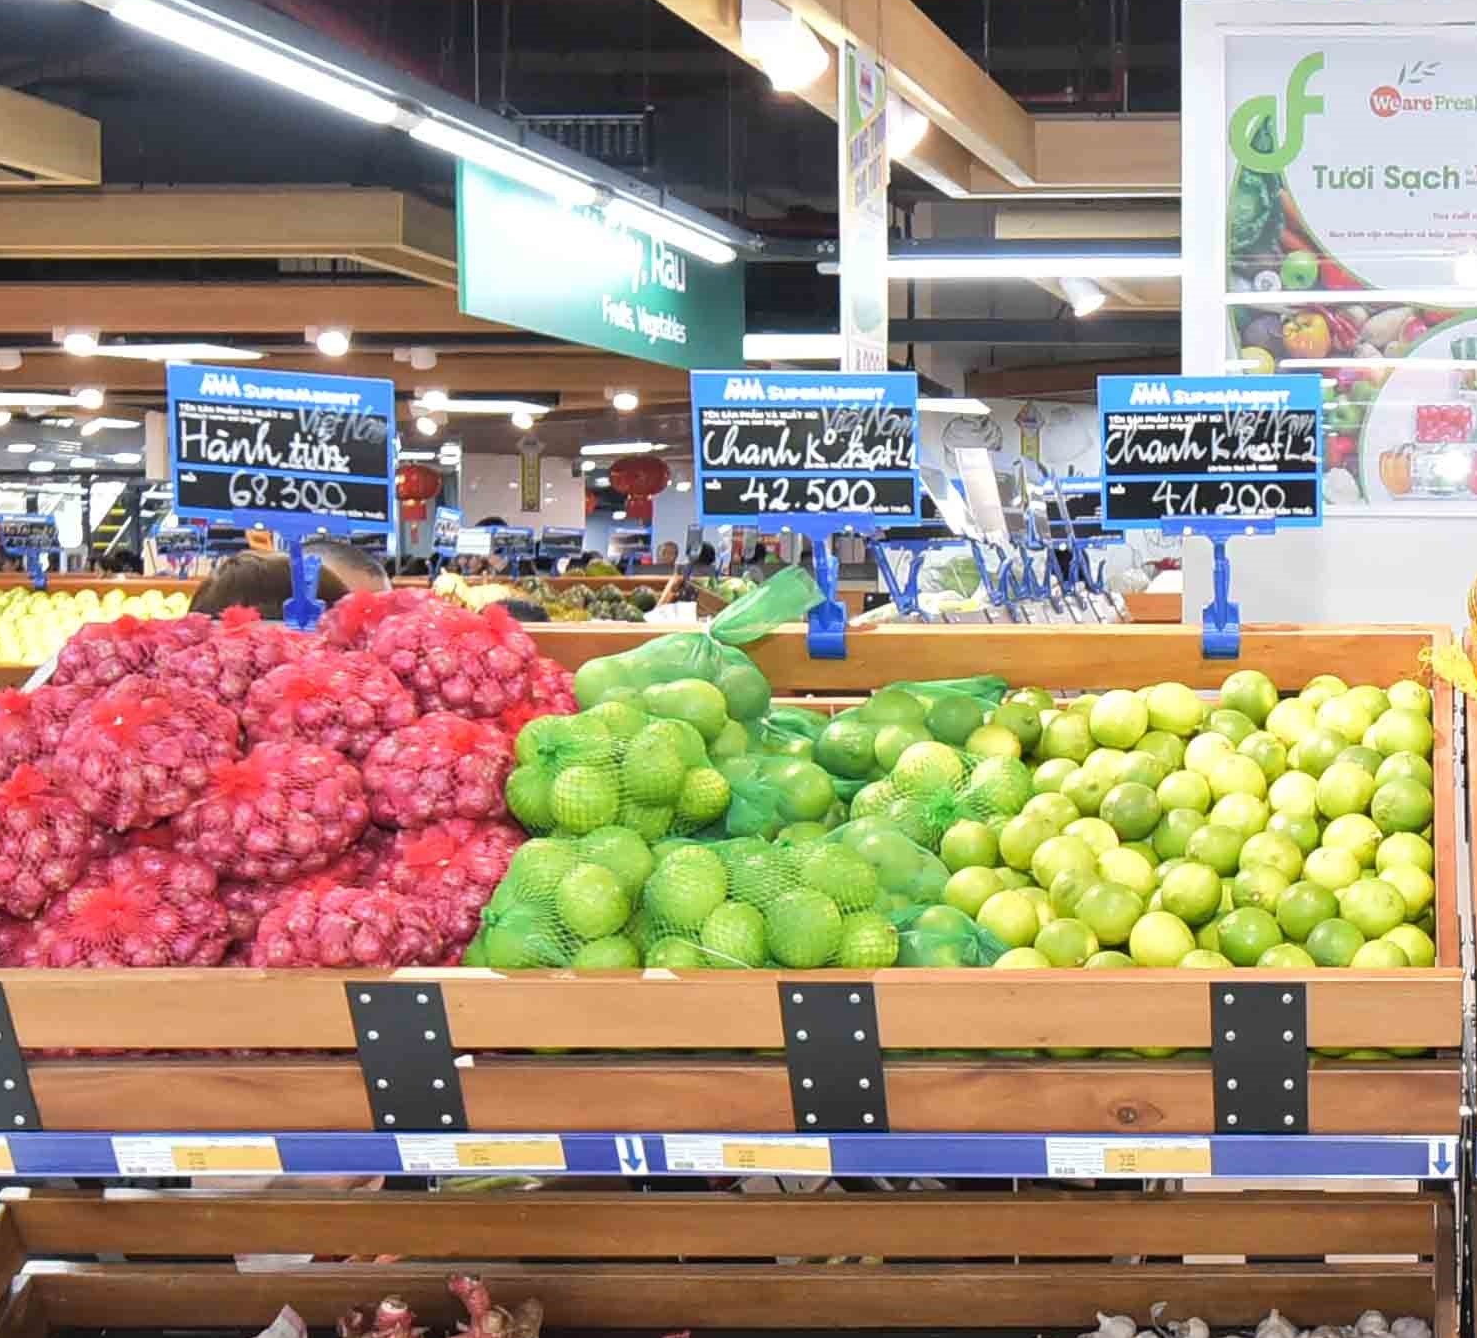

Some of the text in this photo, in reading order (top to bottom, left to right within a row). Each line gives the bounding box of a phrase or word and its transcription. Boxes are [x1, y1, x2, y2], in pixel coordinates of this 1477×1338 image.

[1312, 165, 1373, 189] Tươi
[1384, 164, 1460, 197] Sạch
[651, 239, 686, 293] Rau
[703, 425, 801, 468] Chanh
[1105, 421, 1207, 466] Chanh
[230, 470, 347, 509] 68.300
[739, 477, 876, 511] 42.500
[1152, 480, 1285, 514] 41.200
